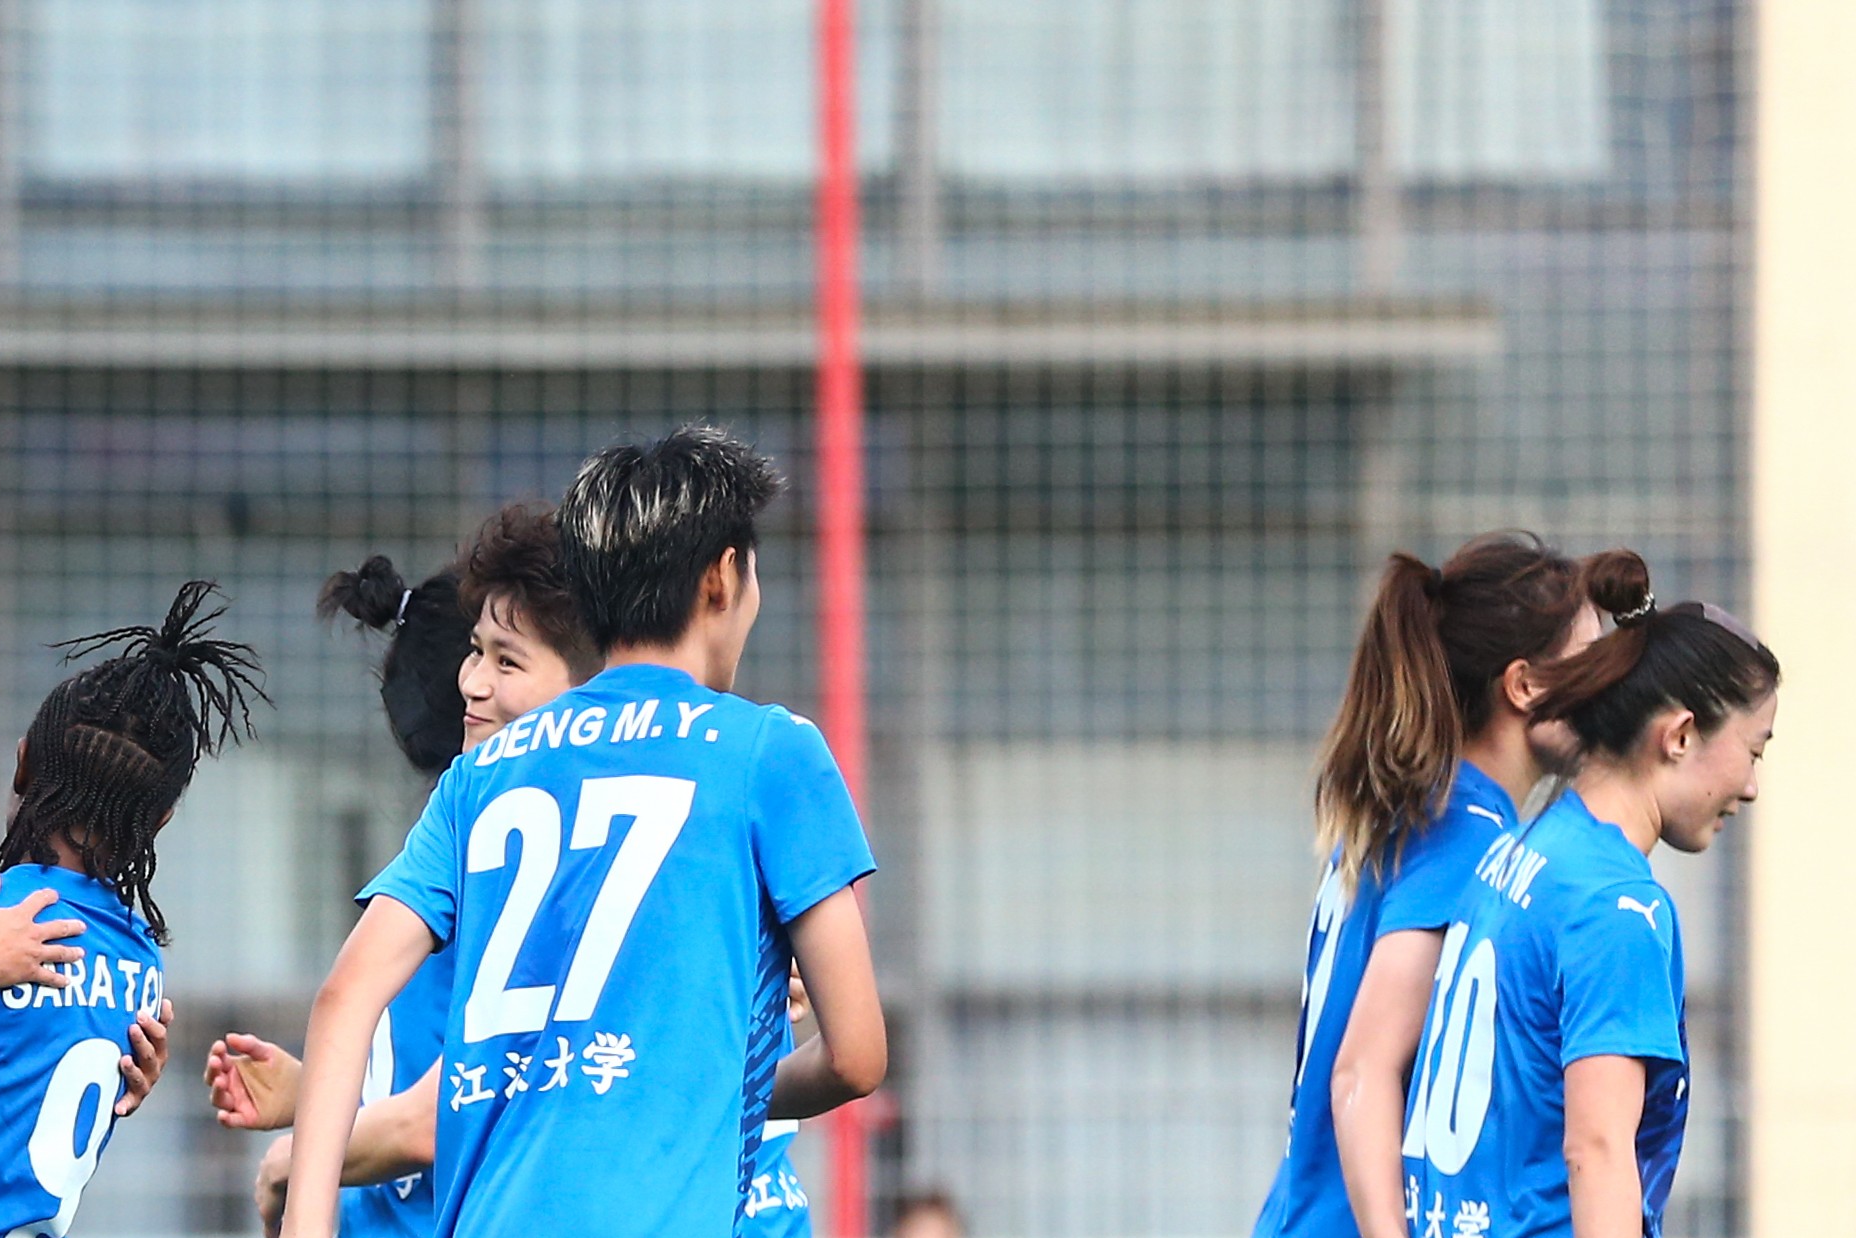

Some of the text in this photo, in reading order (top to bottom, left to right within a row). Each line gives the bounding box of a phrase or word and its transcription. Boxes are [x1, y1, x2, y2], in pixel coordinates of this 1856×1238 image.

[474, 706, 608, 767] DENG
[2, 954, 163, 1021] SARATO
[463, 774, 697, 1044] 27
[1402, 920, 1498, 1175] 10
